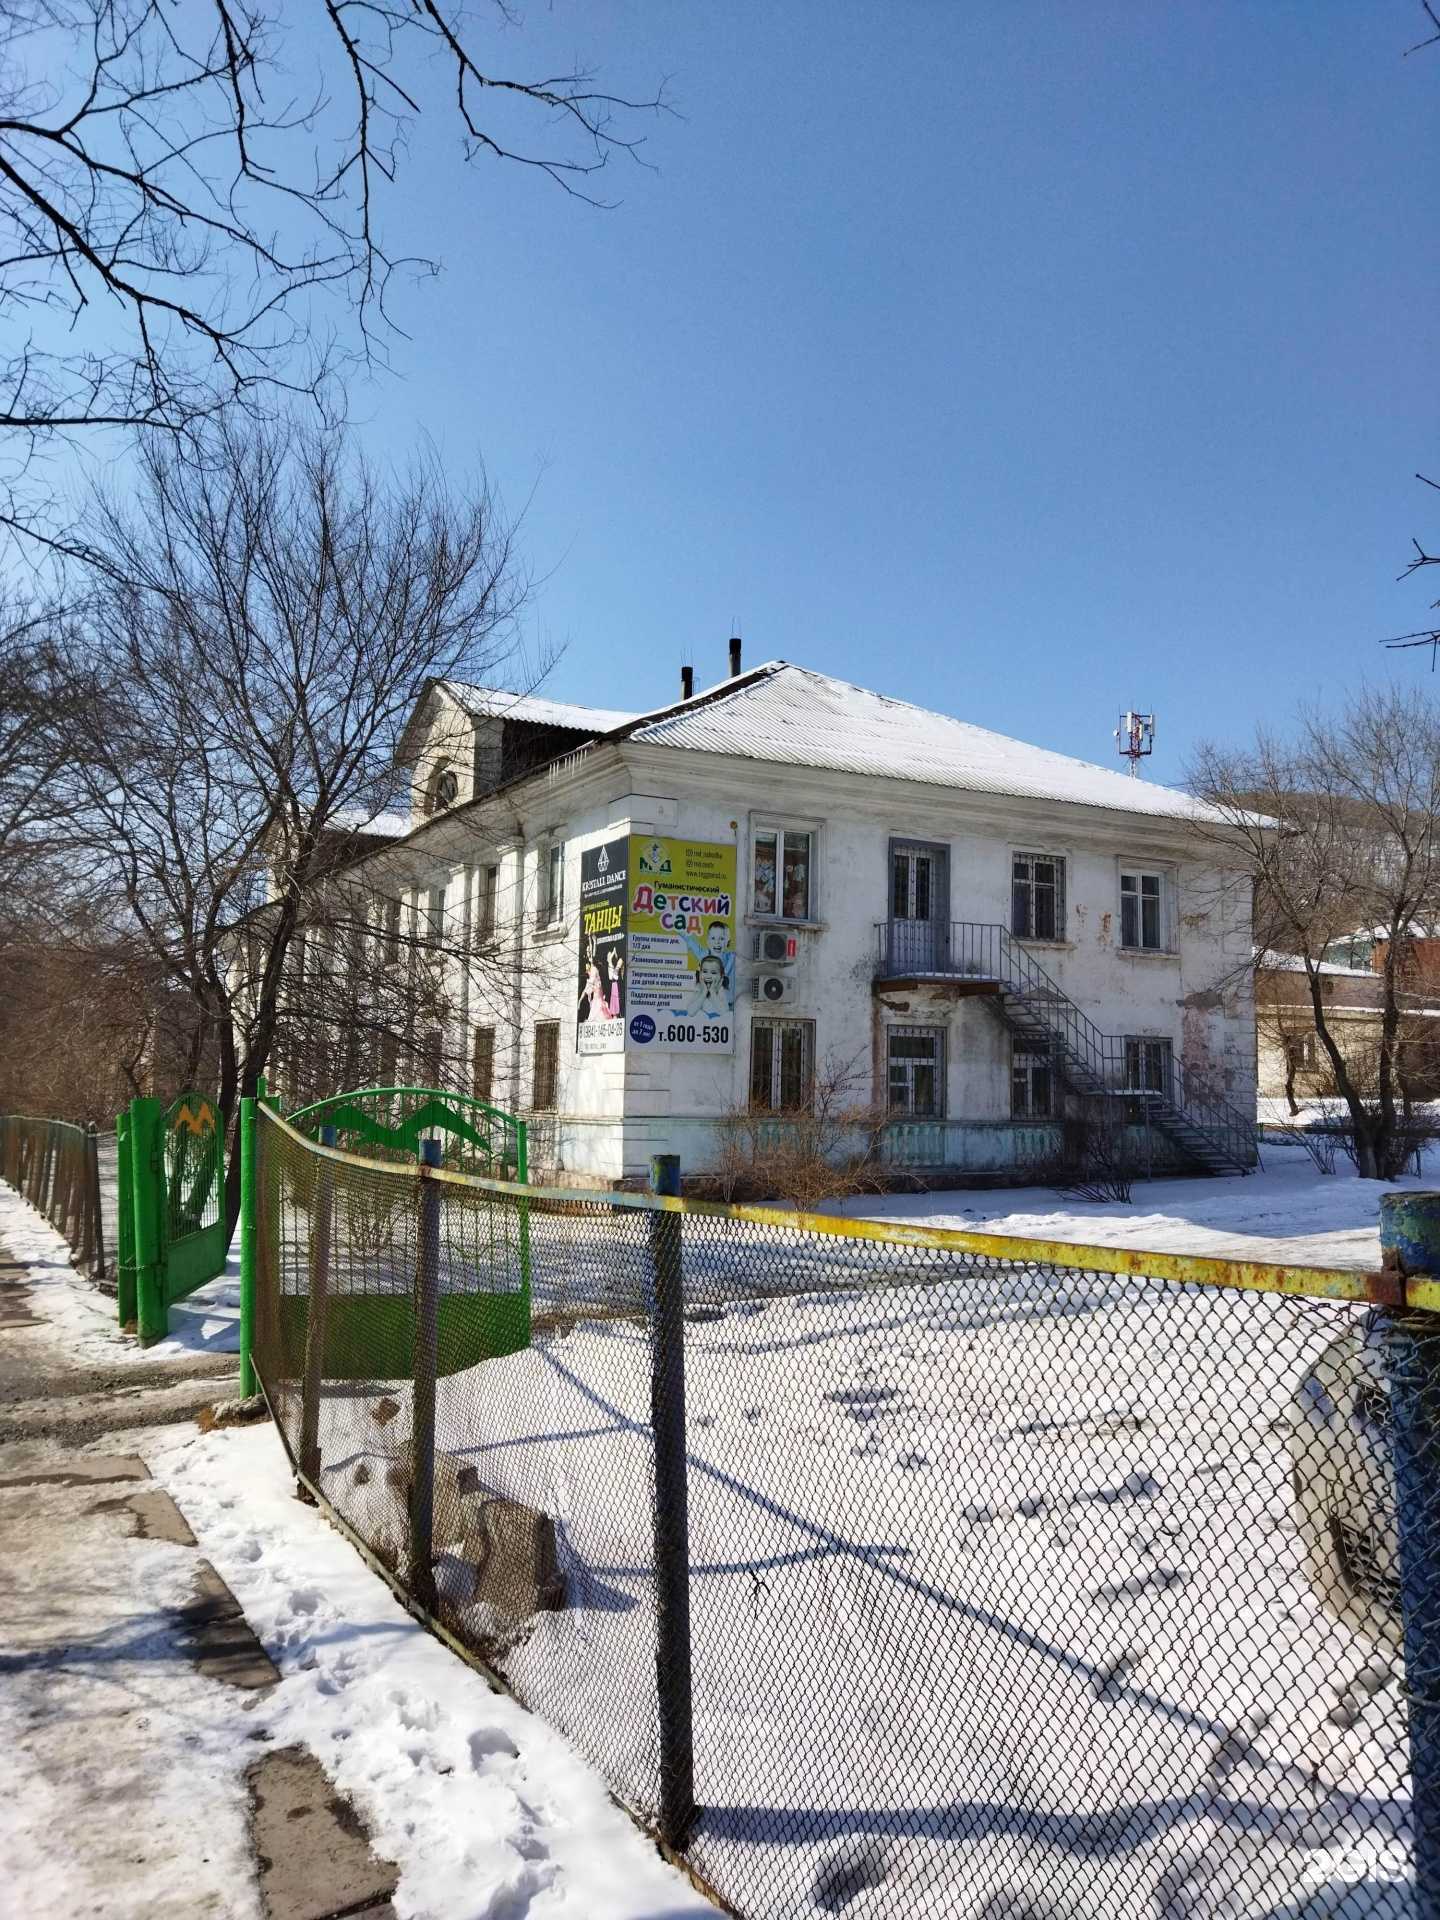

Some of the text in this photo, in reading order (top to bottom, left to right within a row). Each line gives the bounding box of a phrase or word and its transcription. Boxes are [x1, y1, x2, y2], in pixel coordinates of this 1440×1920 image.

[607, 870, 627, 884] DANCE
[654, 881, 720, 893] Гуманистический
[633, 885, 730, 915] Детский
[584, 905, 623, 934] ТАНЦЫ
[661, 913, 702, 934] сад
